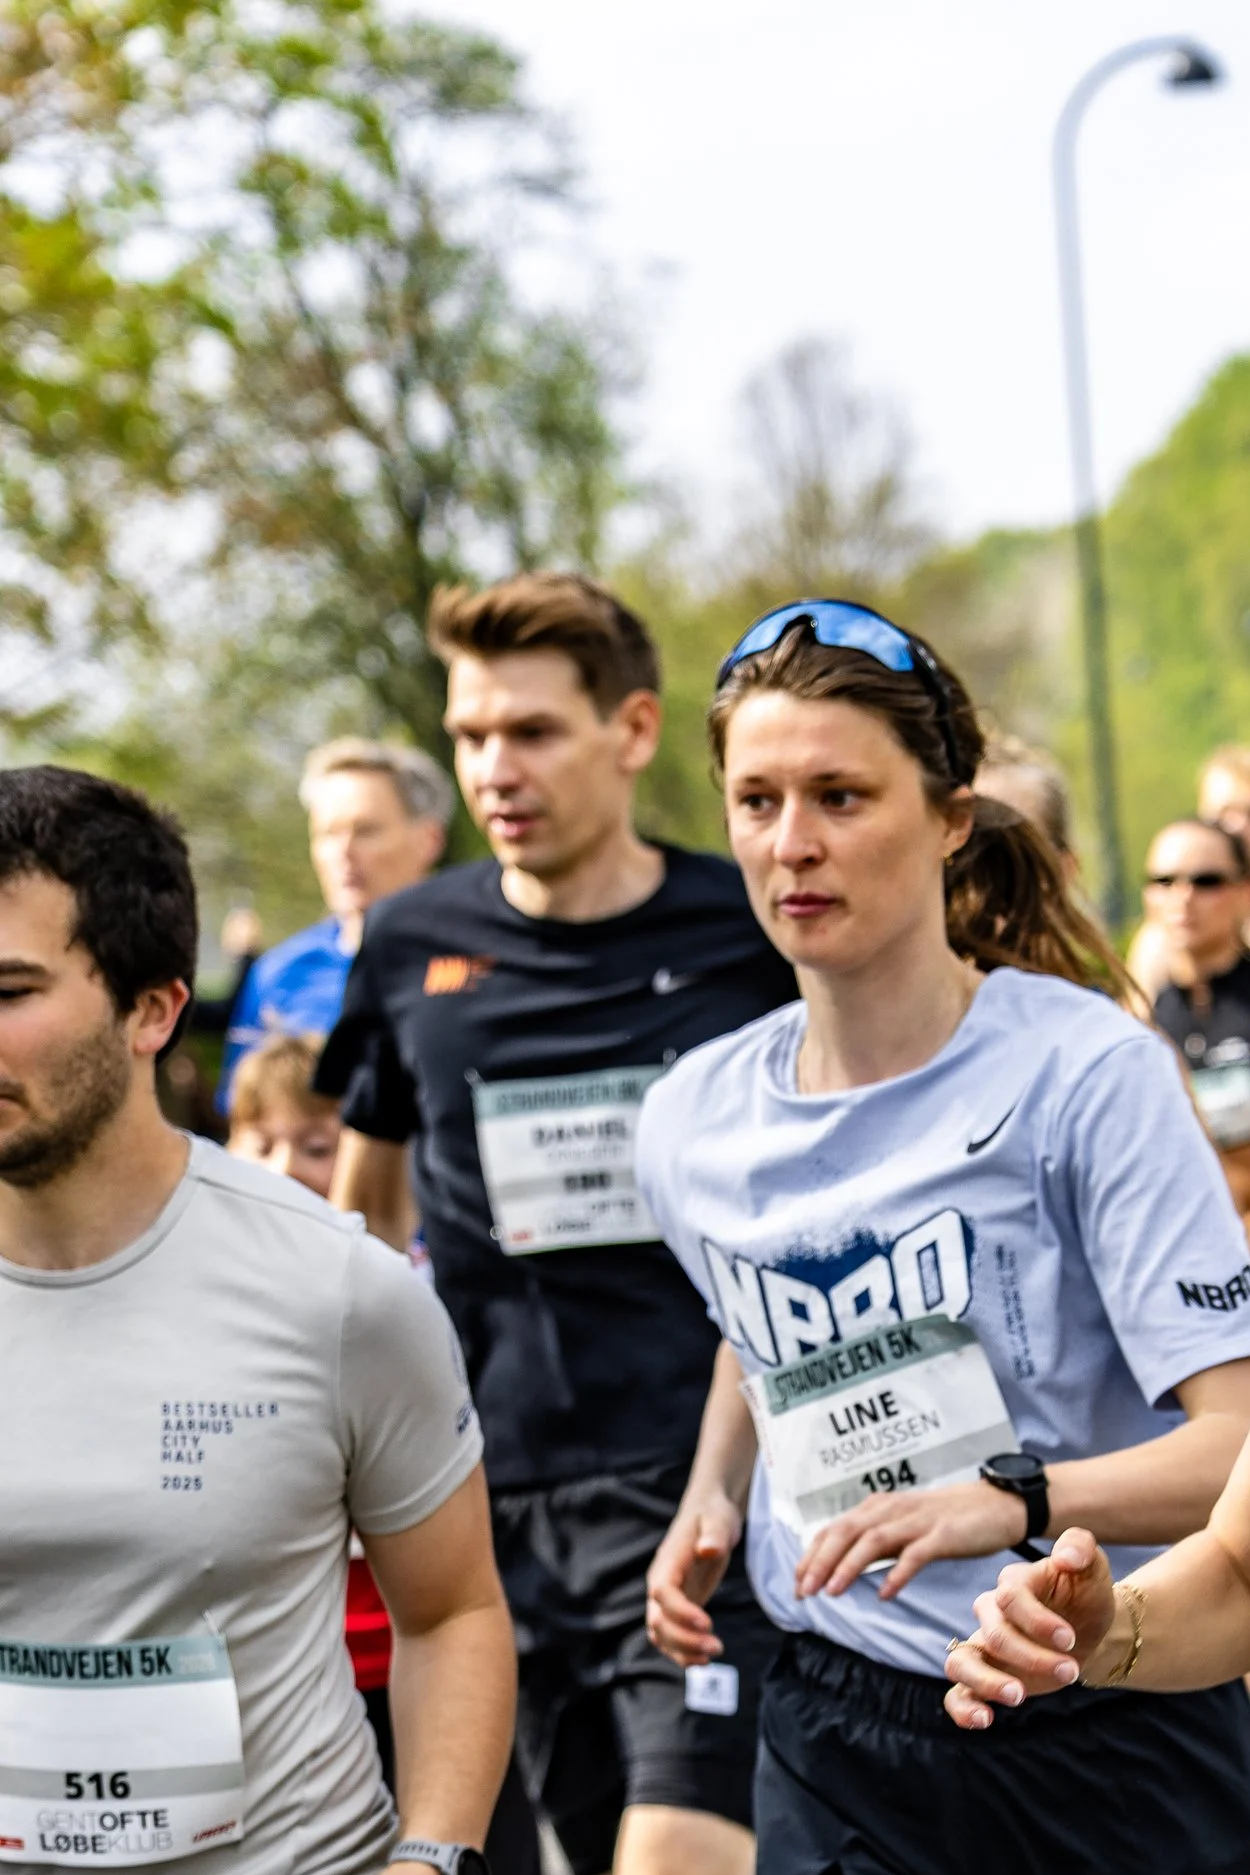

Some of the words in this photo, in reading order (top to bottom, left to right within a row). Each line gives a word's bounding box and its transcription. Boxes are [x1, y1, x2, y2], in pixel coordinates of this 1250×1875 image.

[885, 1325, 921, 1360] 5K
[161, 1402, 280, 1418] BESTSELLER
[829, 1390, 900, 1437] LINE
[162, 1419, 235, 1435] AARHUS
[820, 1410, 941, 1467] RASMUSSEN
[162, 1435, 201, 1449] CITY
[162, 1450, 205, 1464] HALF
[861, 1458, 918, 1494] 194
[140, 1646, 172, 1678] 5K
[64, 1770, 131, 1801] 516
[36, 1808, 170, 1832] GENTOFTE
[39, 1831, 174, 1854] LØBEKLUB
